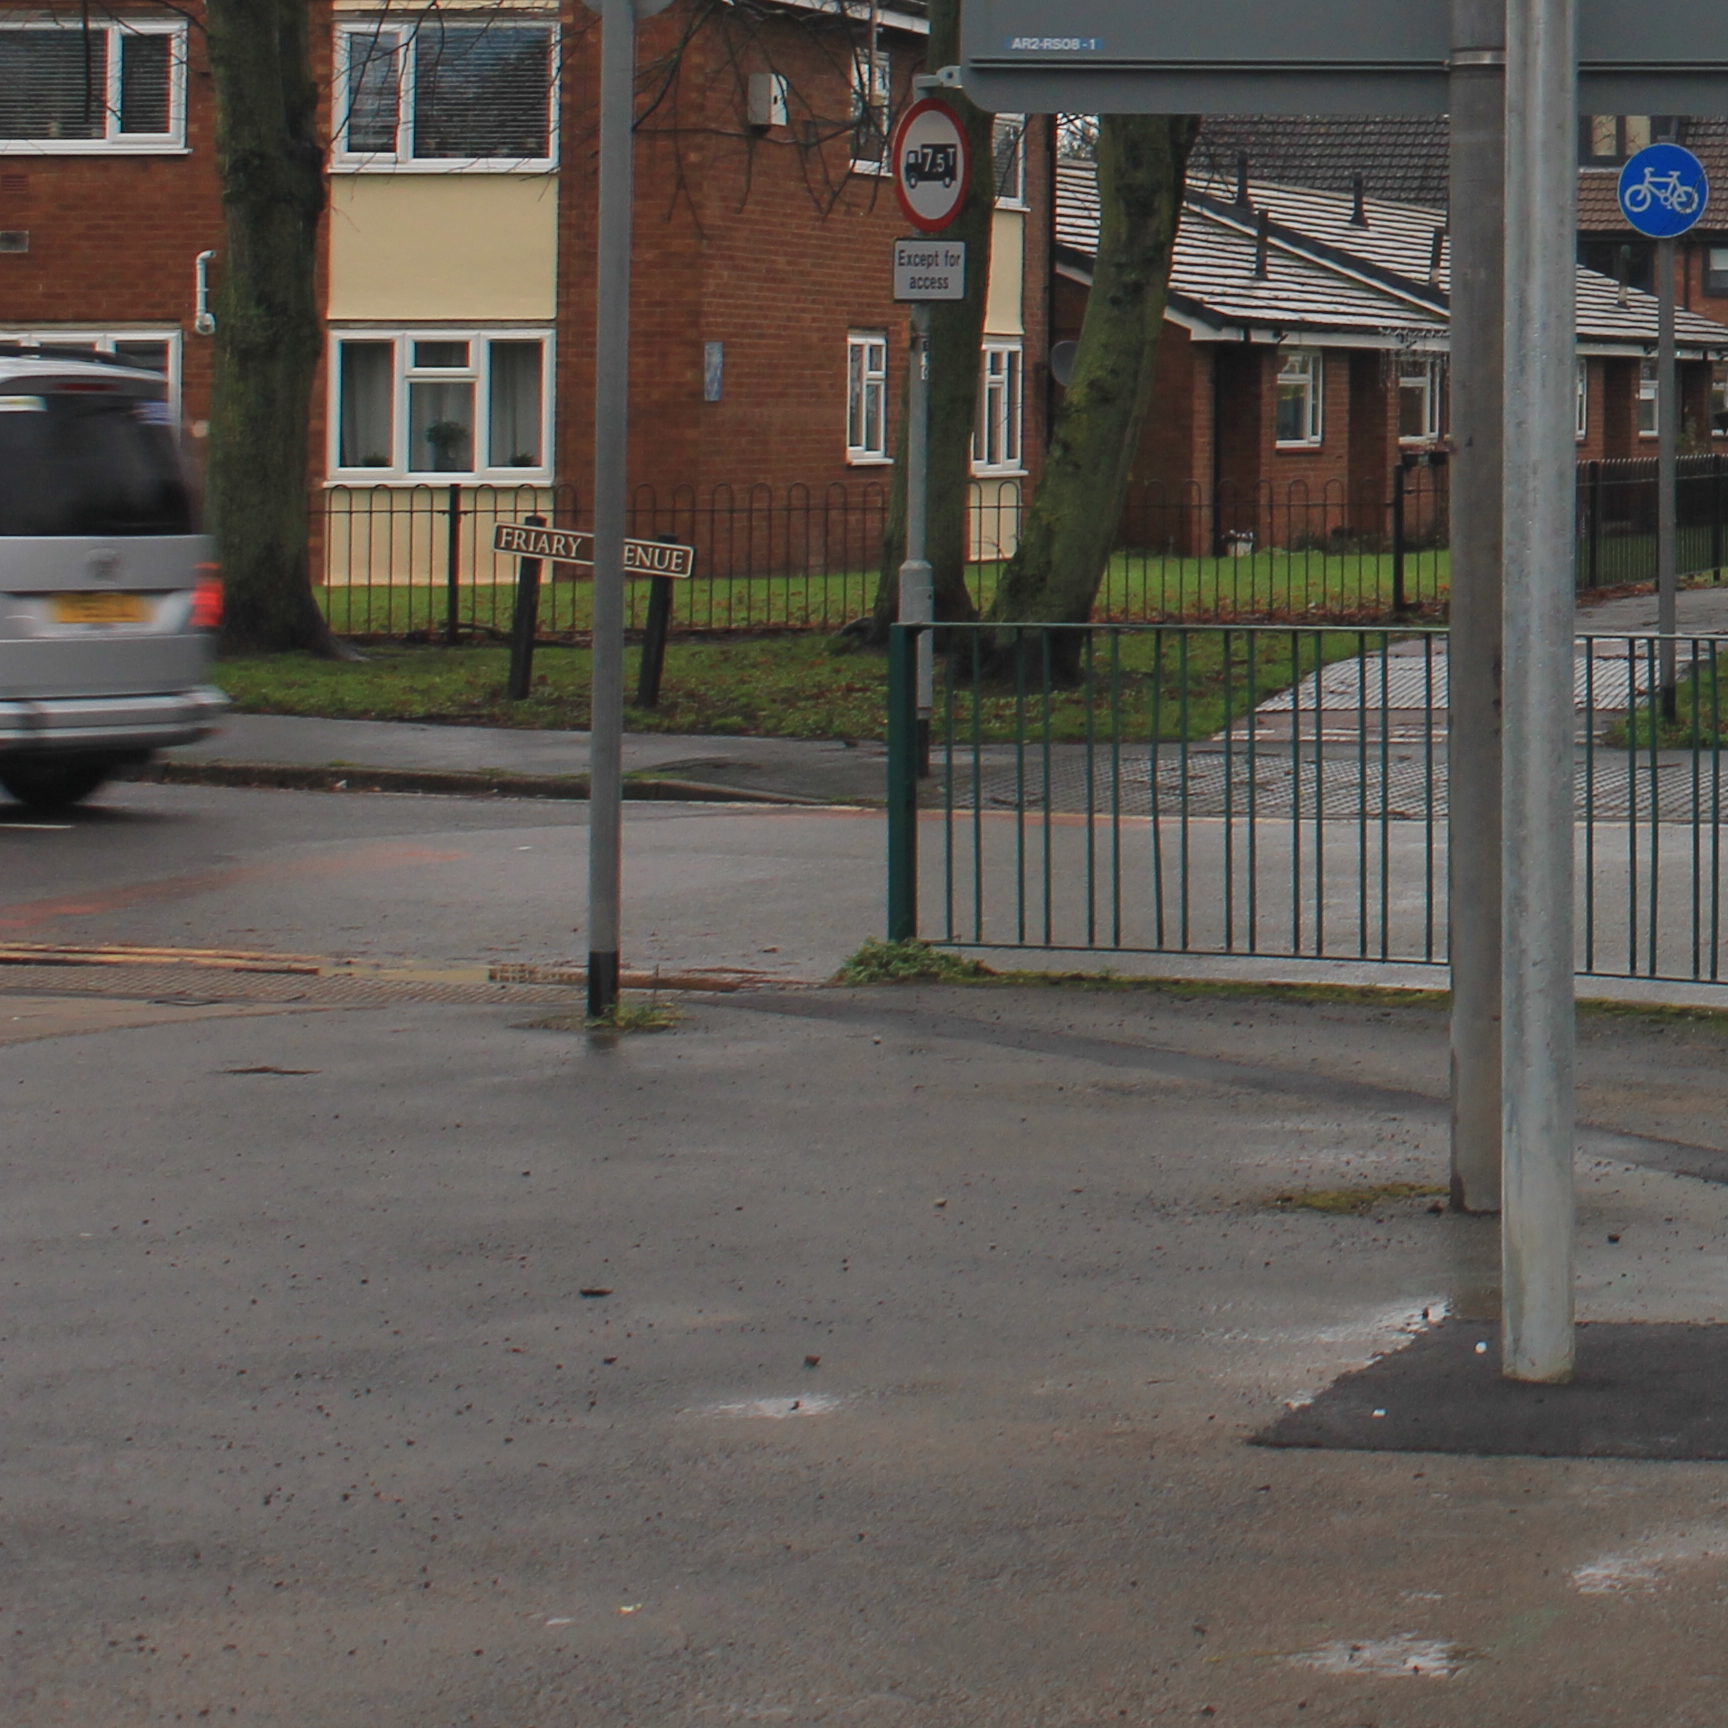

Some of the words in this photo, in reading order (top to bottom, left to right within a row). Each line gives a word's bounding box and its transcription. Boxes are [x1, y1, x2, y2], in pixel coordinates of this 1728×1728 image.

[898, 248, 940, 270] Except
[943, 249, 962, 269] for
[909, 274, 950, 291] access
[500, 527, 583, 558] FRIARY
[623, 544, 685, 572] ENUE
